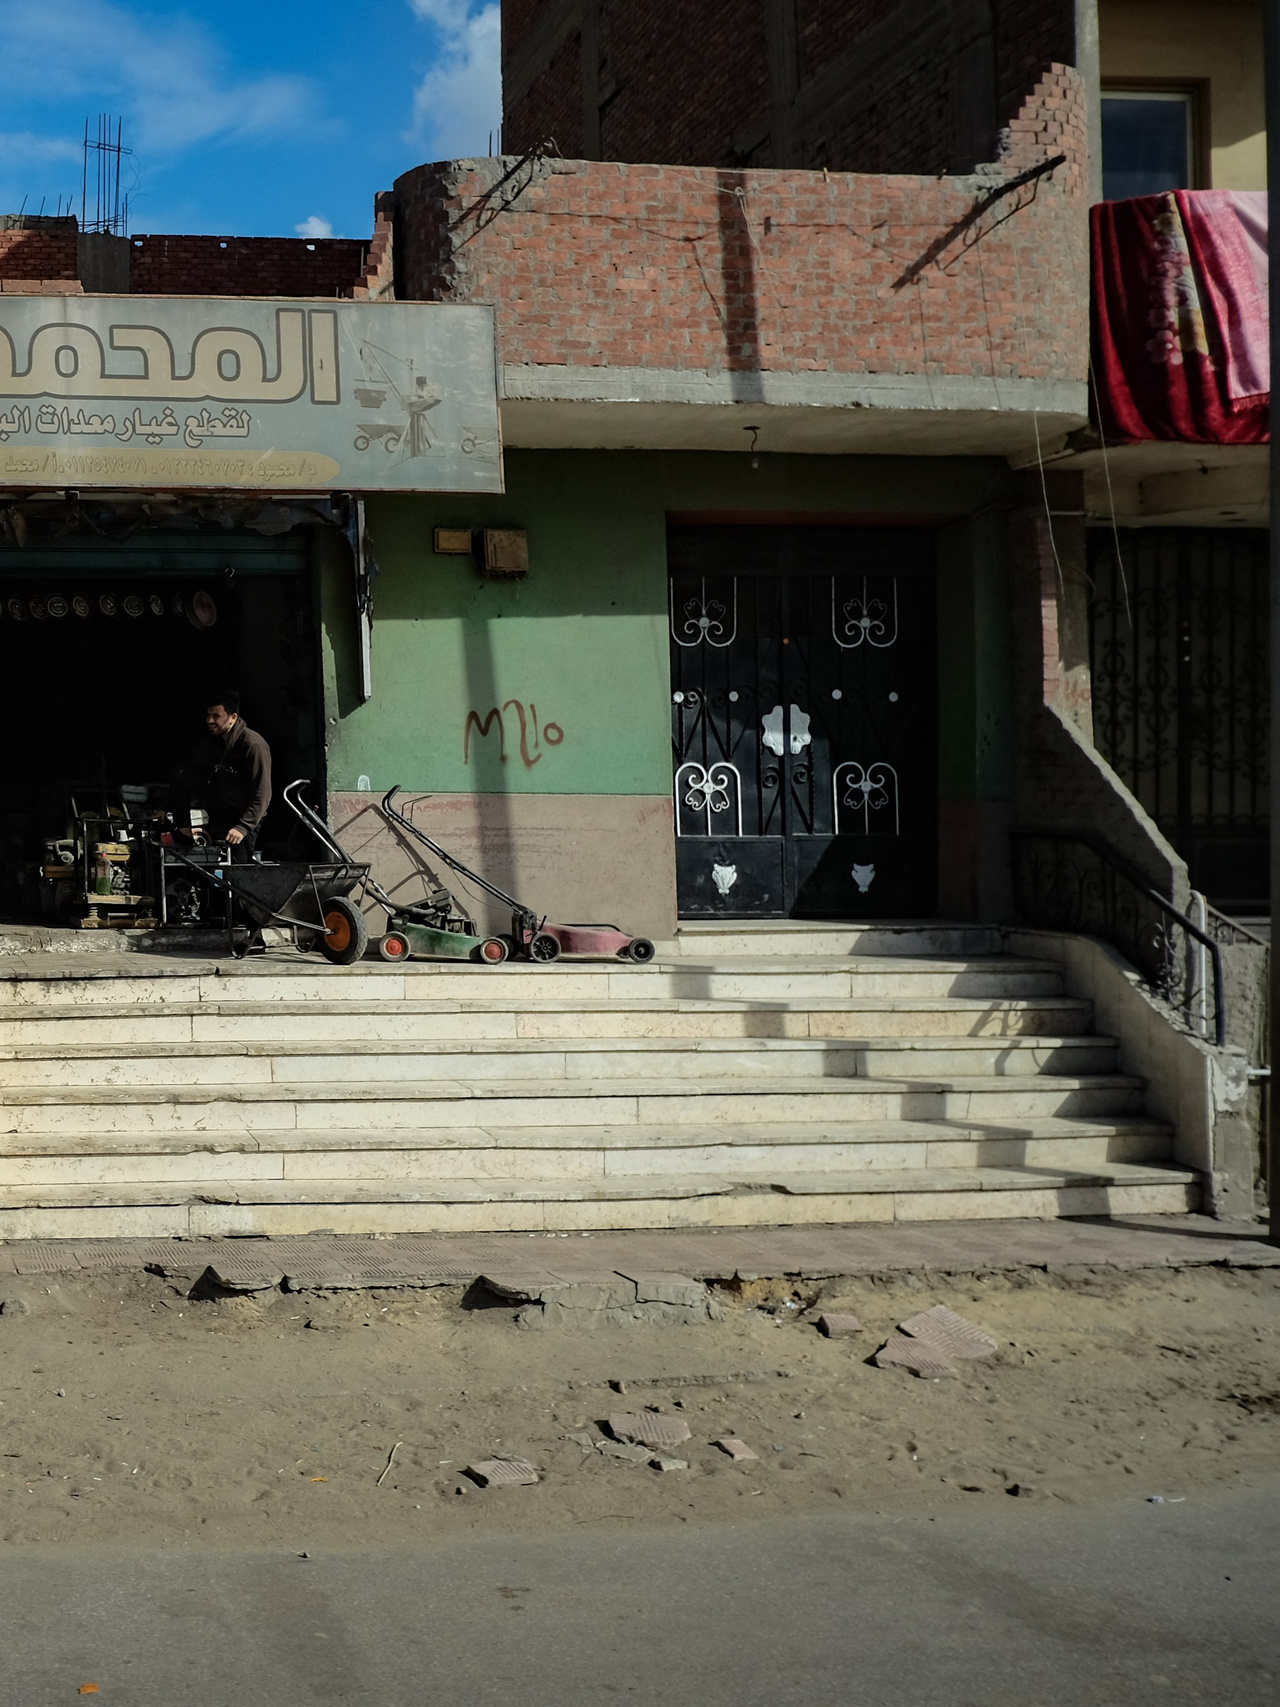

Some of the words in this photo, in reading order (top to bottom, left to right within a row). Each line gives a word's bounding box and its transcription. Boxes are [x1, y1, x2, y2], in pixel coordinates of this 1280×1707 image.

[35, 405, 116, 435] معدات
[115, 406, 180, 445] غيار
[183, 408, 252, 448] لقطع
